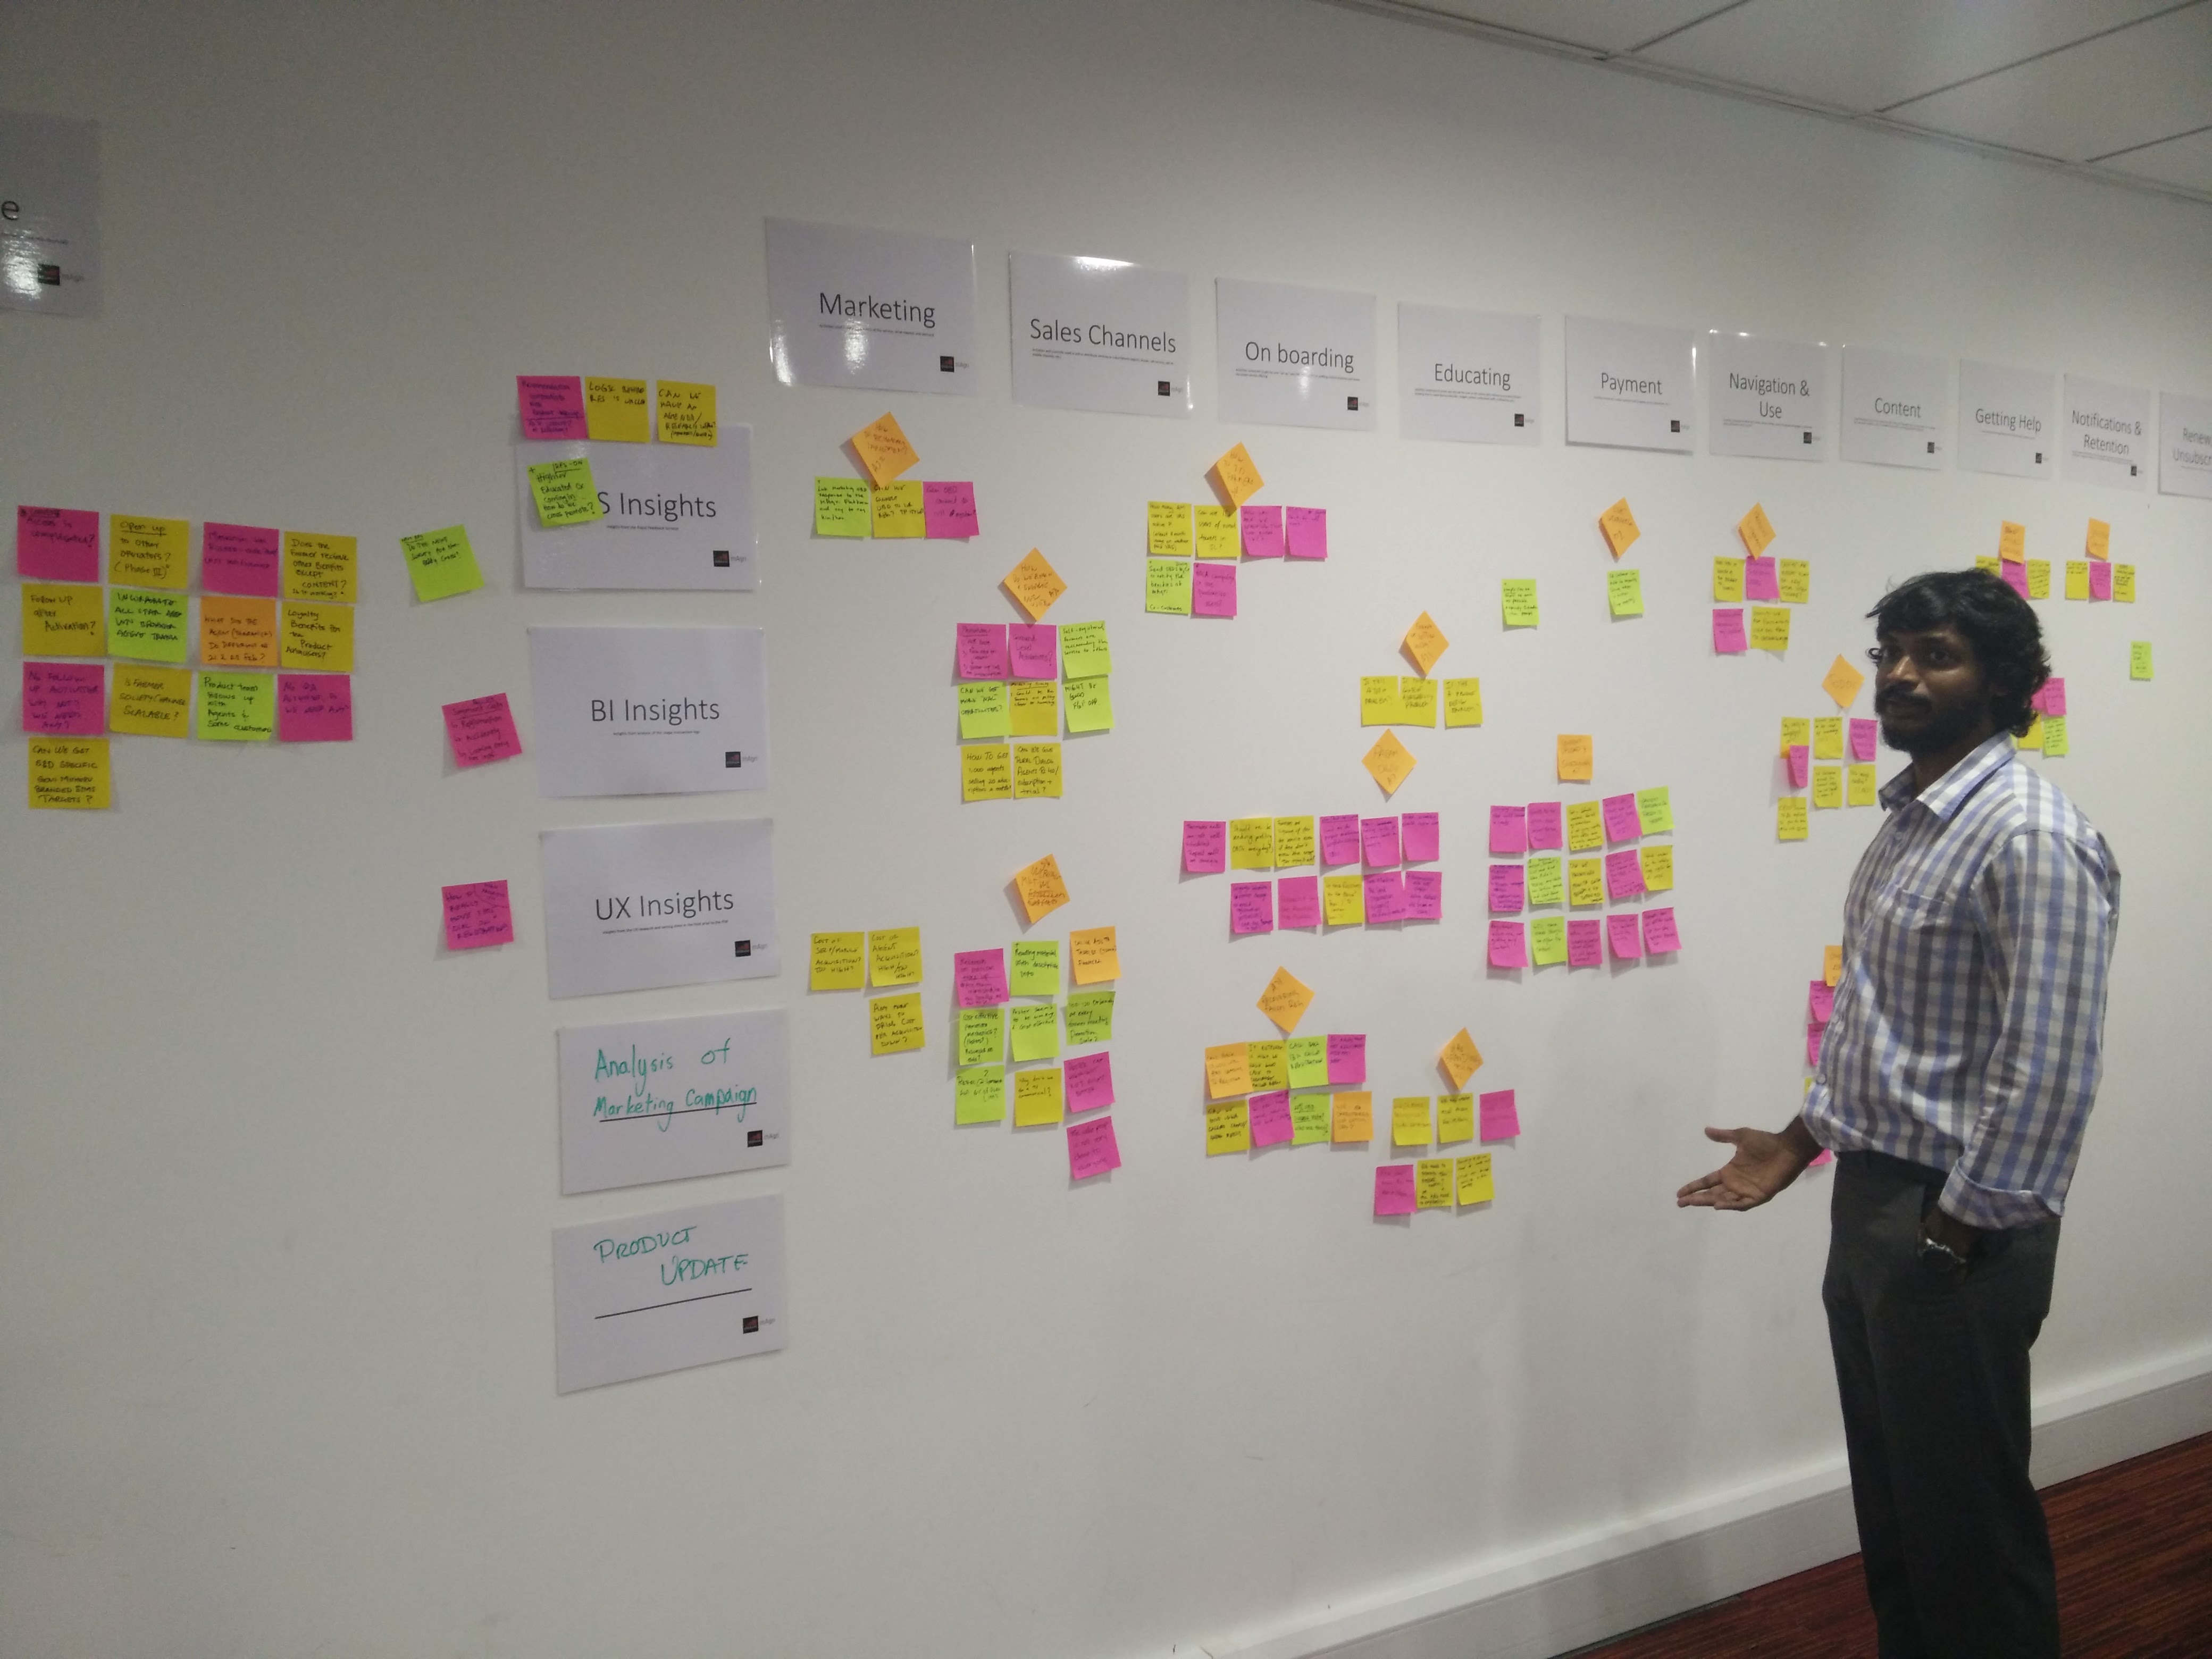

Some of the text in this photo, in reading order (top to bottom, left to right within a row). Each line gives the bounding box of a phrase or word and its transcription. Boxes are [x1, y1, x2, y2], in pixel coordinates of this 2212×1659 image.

[820, 292, 935, 329] Marketing
[1030, 319, 1176, 353] Sales Channels
[1246, 341, 1354, 373] On boarding
[1435, 363, 1511, 391] Educating
[1602, 373, 1662, 395] Payment
[1730, 373, 1809, 396] Navigation &
[659, 389, 680, 398] CAN
[1759, 401, 1782, 418] Use
[1875, 398, 1922, 418] Content
[1976, 408, 2041, 433] Getting Help
[2072, 410, 2141, 435] Notifications &
[2084, 434, 2129, 455] Retention
[620, 492, 717, 522] Insights
[301, 640, 332, 650] Product
[205, 677, 234, 690] Product
[244, 696, 254, 705] up
[591, 697, 720, 726] BI Insights
[208, 709, 236, 720] Agents
[985, 751, 993, 760] TO
[596, 889, 734, 920] UX Insights
[595, 1037, 731, 1097] Analysis of
[593, 1084, 757, 1132] Marketing Campaign
[593, 1226, 697, 1262] PRODUCT
[661, 1254, 749, 1285] UPDATE
